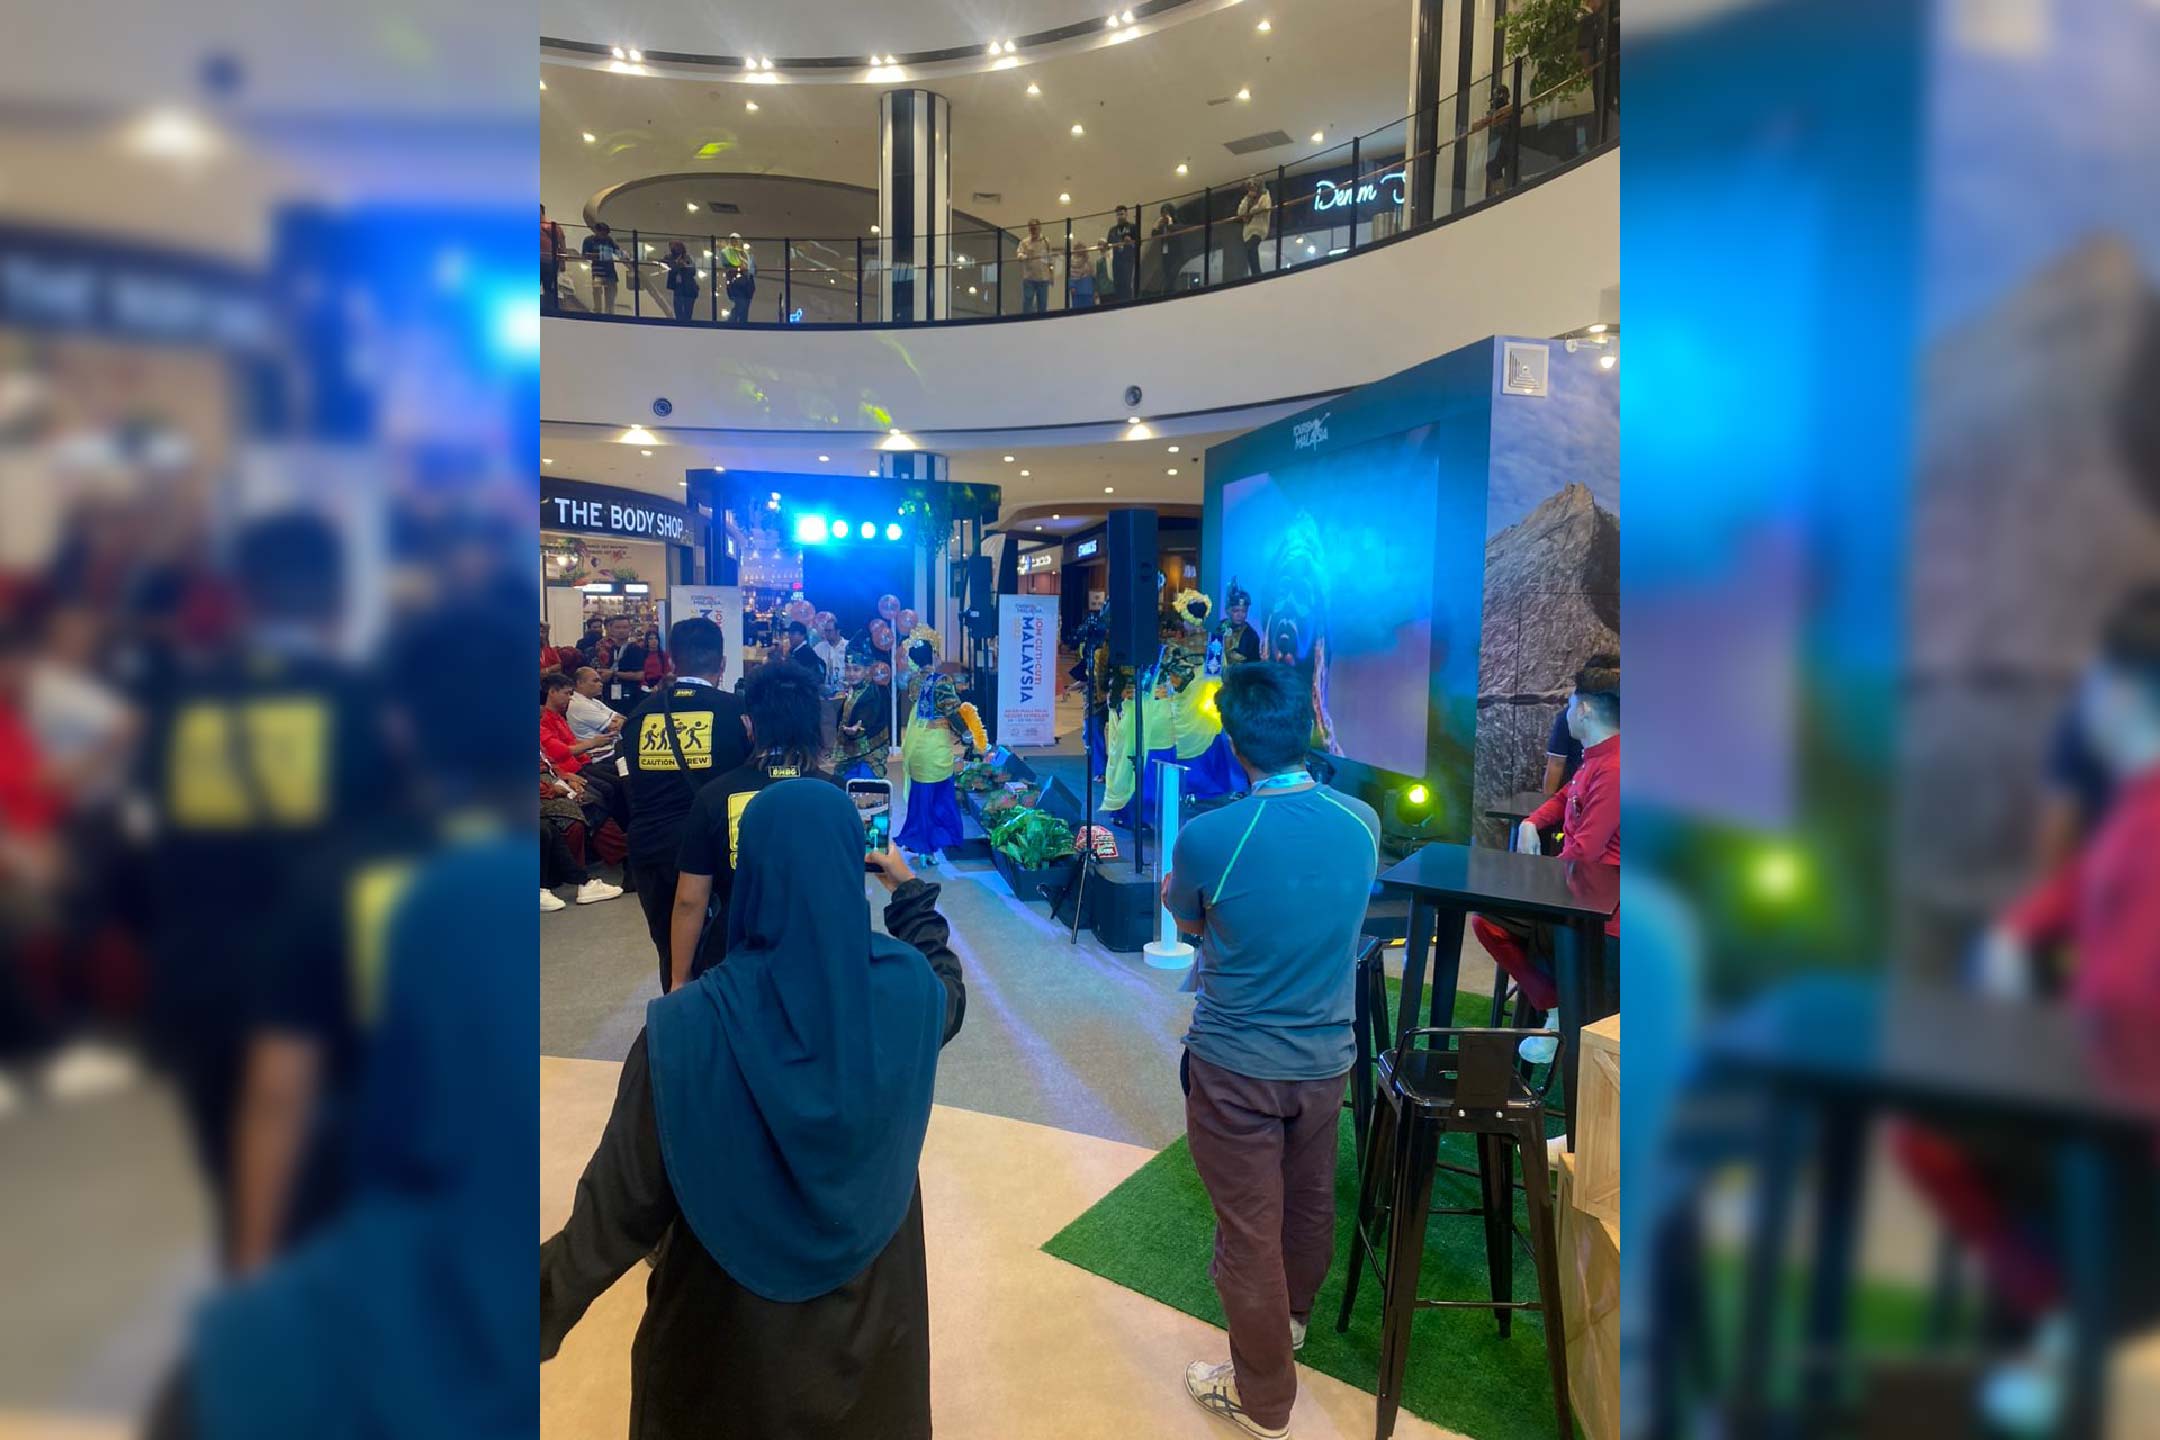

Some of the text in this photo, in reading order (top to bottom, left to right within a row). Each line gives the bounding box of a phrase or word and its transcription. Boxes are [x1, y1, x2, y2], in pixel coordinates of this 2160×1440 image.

[1314, 179, 1377, 210] Denm
[554, 497, 684, 539] THE BODY SHOP
[1020, 617, 1035, 703] MALAYSIA
[641, 758, 675, 766] CAUTION
